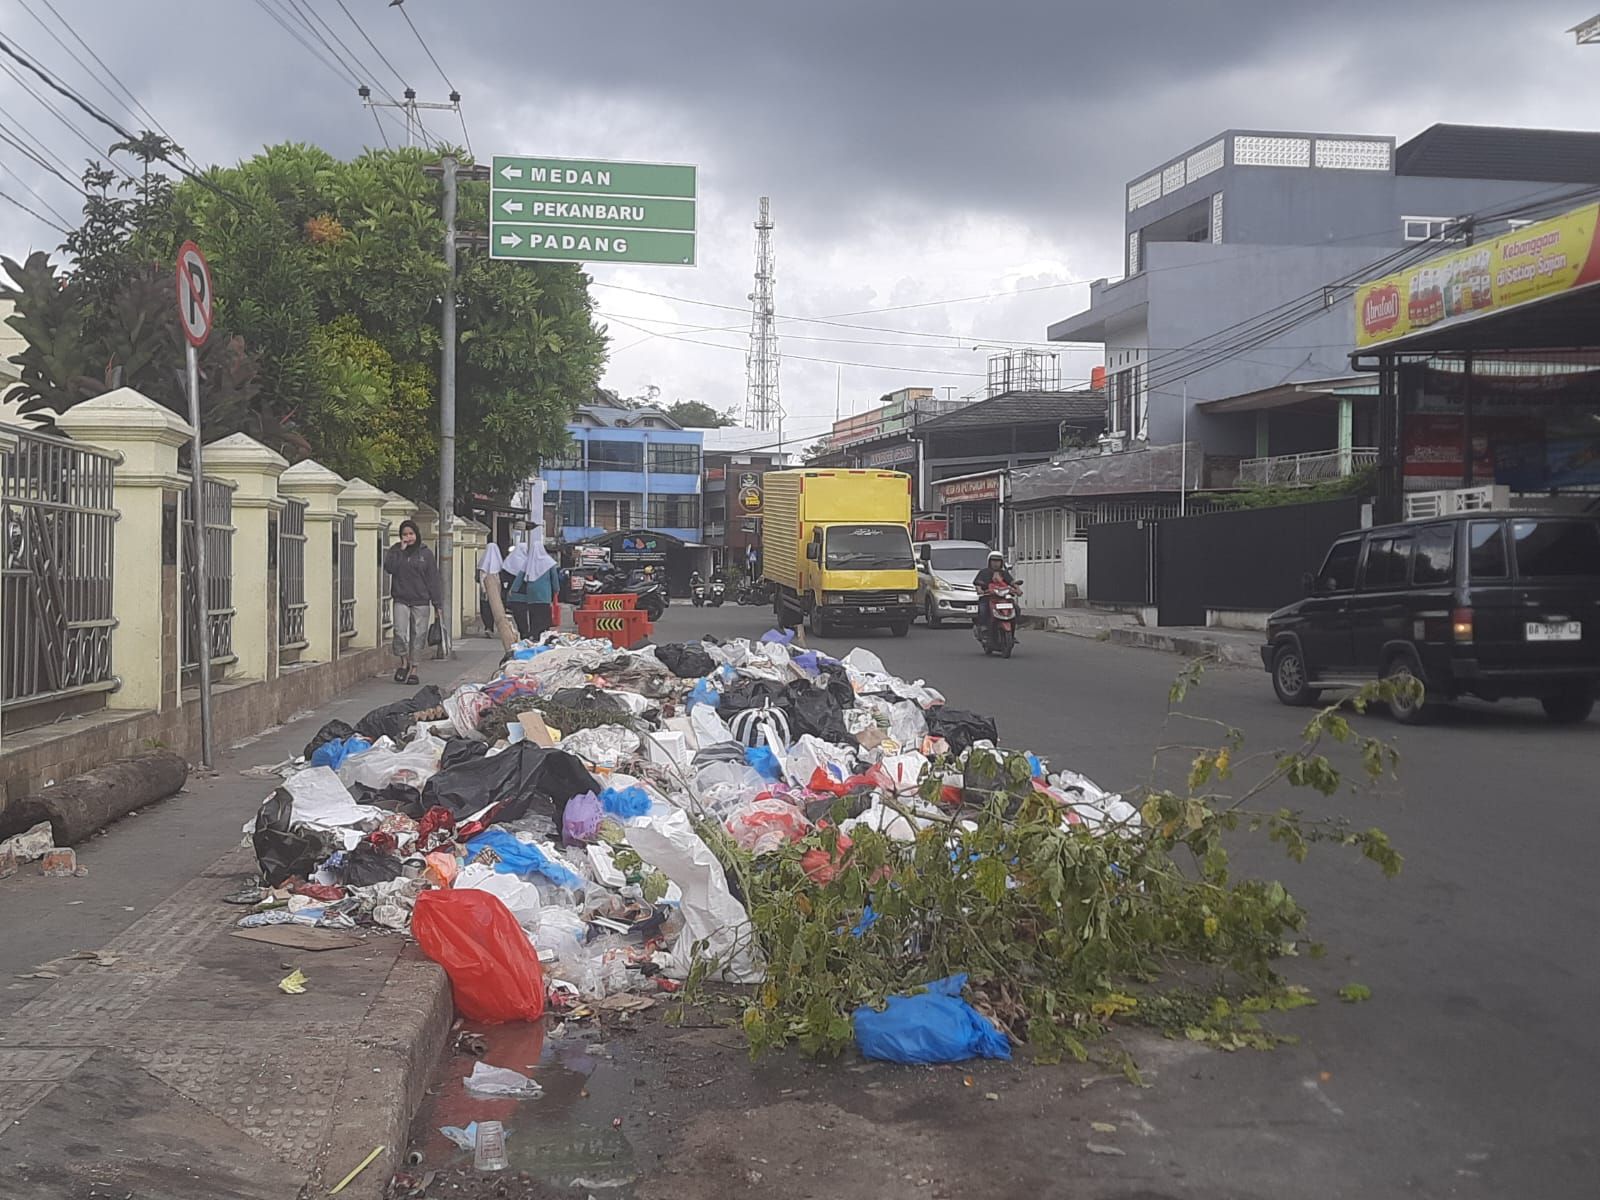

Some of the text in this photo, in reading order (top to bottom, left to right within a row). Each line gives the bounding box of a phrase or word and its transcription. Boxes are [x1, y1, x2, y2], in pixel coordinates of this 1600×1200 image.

[530, 167, 611, 186] MEDAN
[533, 202, 645, 221] PEKANBARU
[530, 234, 628, 253] PADANG
[1502, 231, 1561, 261] Kebanggaan
[1496, 252, 1568, 287] di Setiap Sajian
